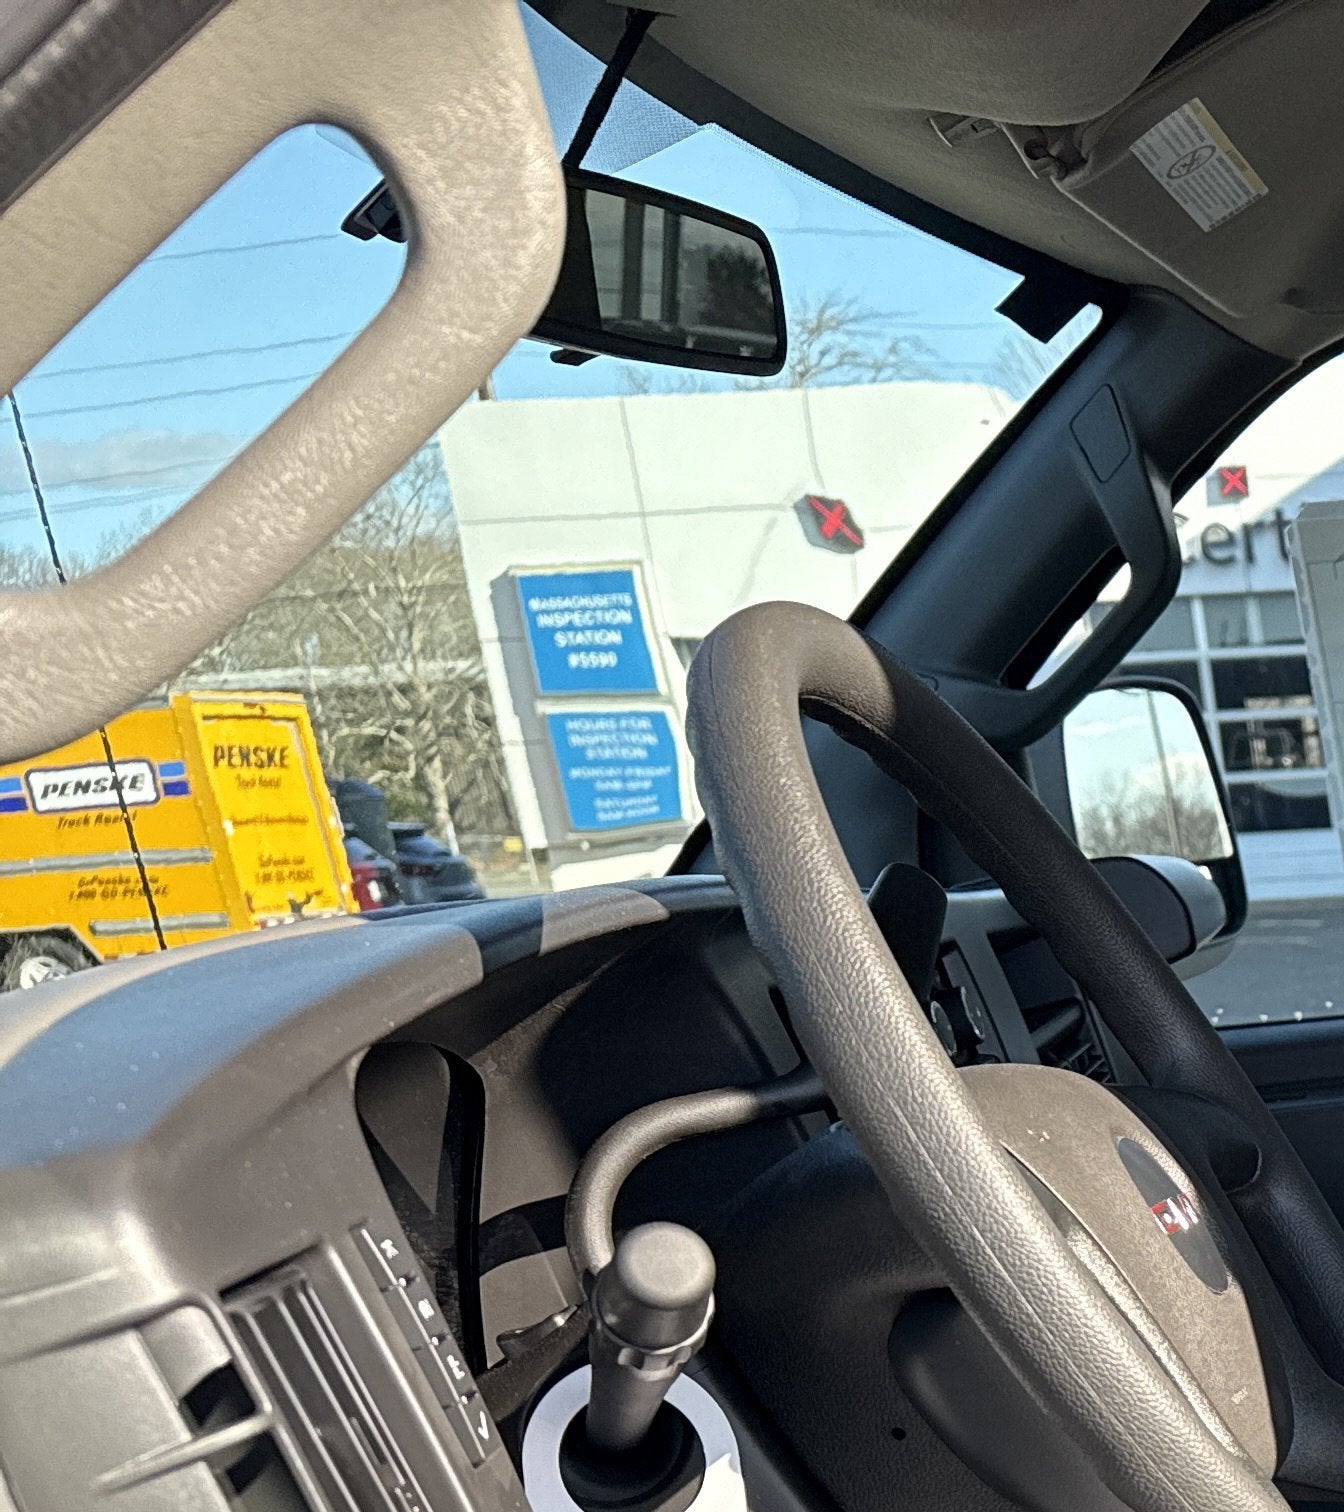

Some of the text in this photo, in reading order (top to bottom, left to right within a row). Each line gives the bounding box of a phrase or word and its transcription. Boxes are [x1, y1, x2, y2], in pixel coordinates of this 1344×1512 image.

[536, 609, 633, 628] INSPECTION
[554, 629, 622, 647] STATION
[213, 745, 289, 769] PENSKE
[41, 773, 145, 800] PENSKE
